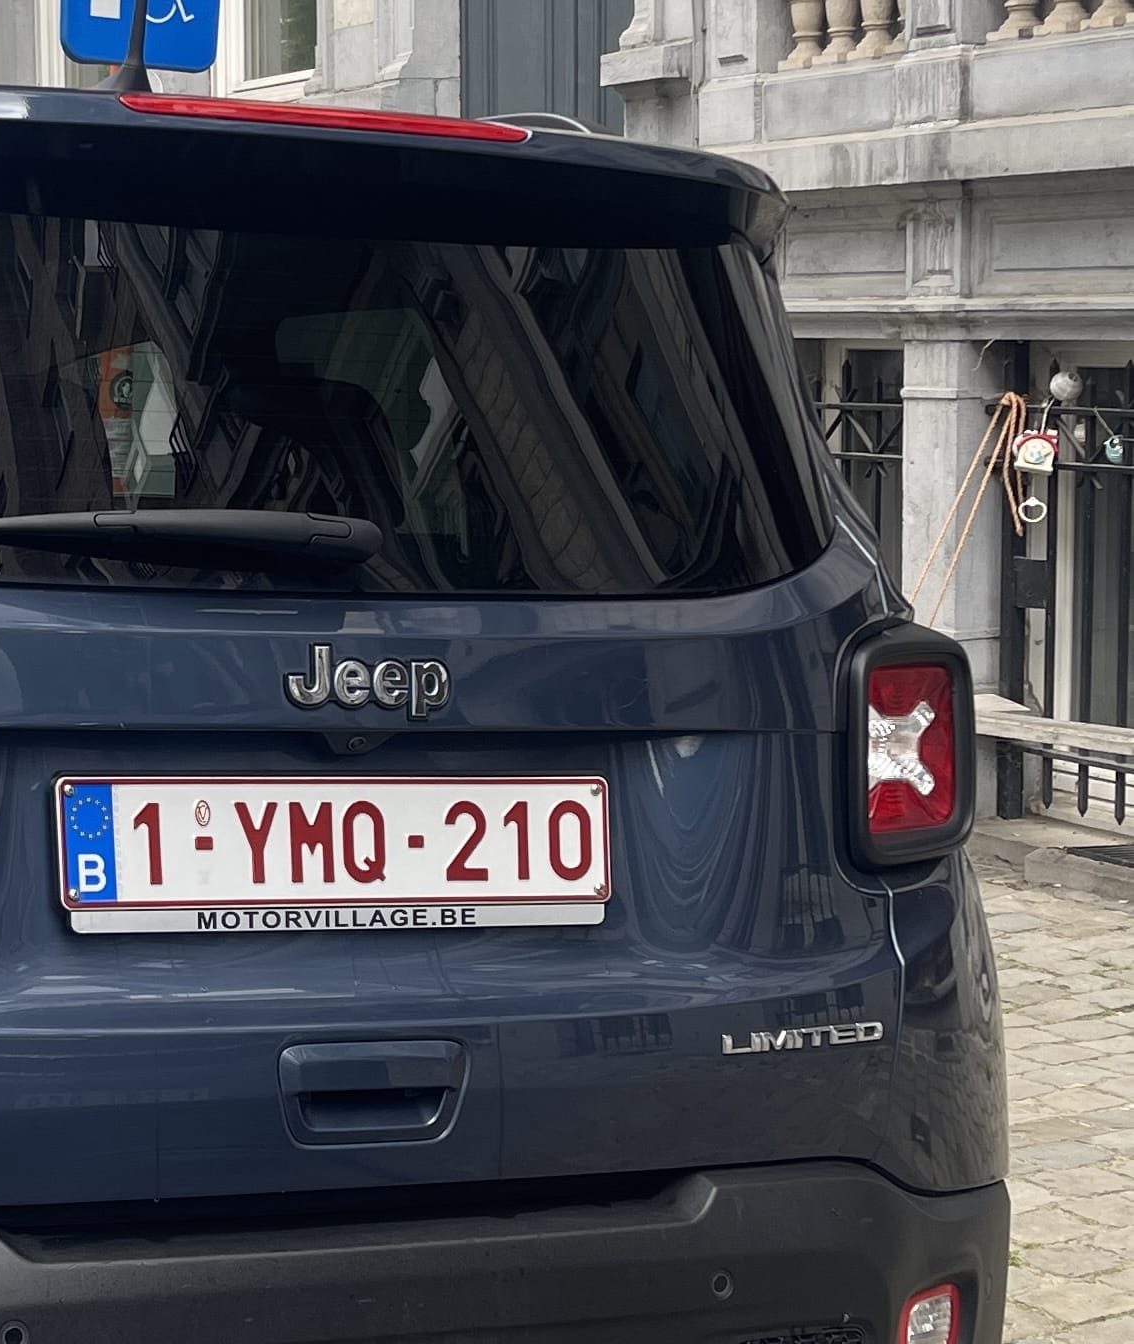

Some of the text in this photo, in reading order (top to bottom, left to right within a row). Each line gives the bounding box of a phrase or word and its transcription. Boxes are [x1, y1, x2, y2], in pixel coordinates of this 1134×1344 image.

[286, 644, 450, 718] Jeep
[132, 799, 592, 886] 1-YMQ-210
[78, 854, 107, 893] B
[197, 908, 477, 931] MOTORVILLAGE.BE
[721, 1021, 884, 1055] LIMITED
